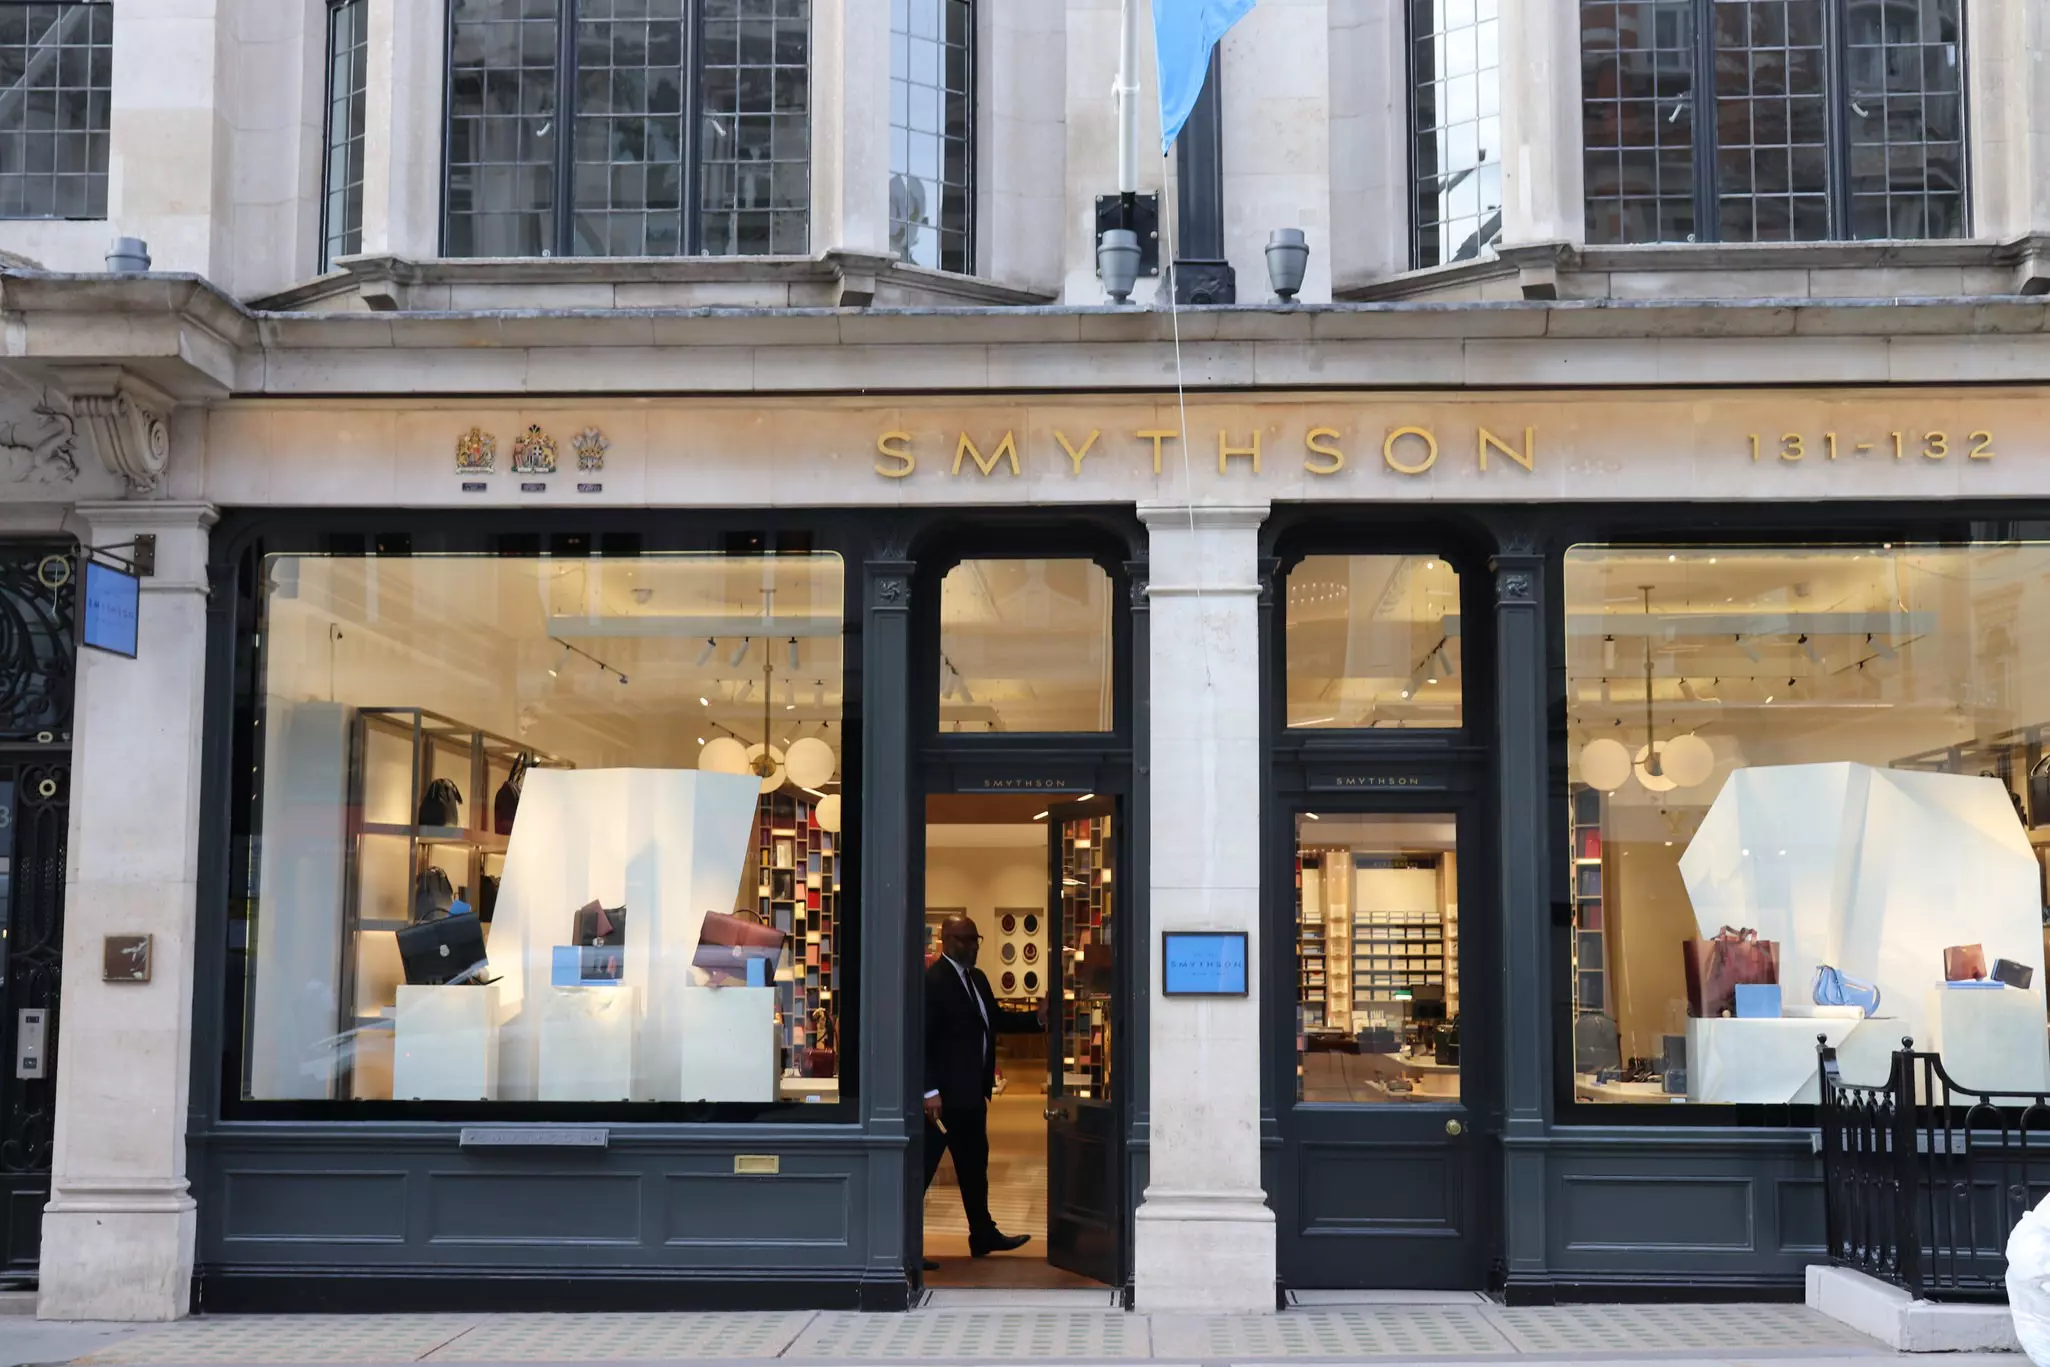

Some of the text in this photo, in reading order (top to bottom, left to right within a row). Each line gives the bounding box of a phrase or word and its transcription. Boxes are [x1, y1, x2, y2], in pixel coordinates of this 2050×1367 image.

[1748, 431, 1996, 462] 131-132
[874, 426, 1534, 478] SMYTHSON
[984, 779, 1065, 788] SMYTHSON
[1336, 777, 1418, 786] SMYTHSON
[1170, 960, 1242, 969] SMYTHSON
